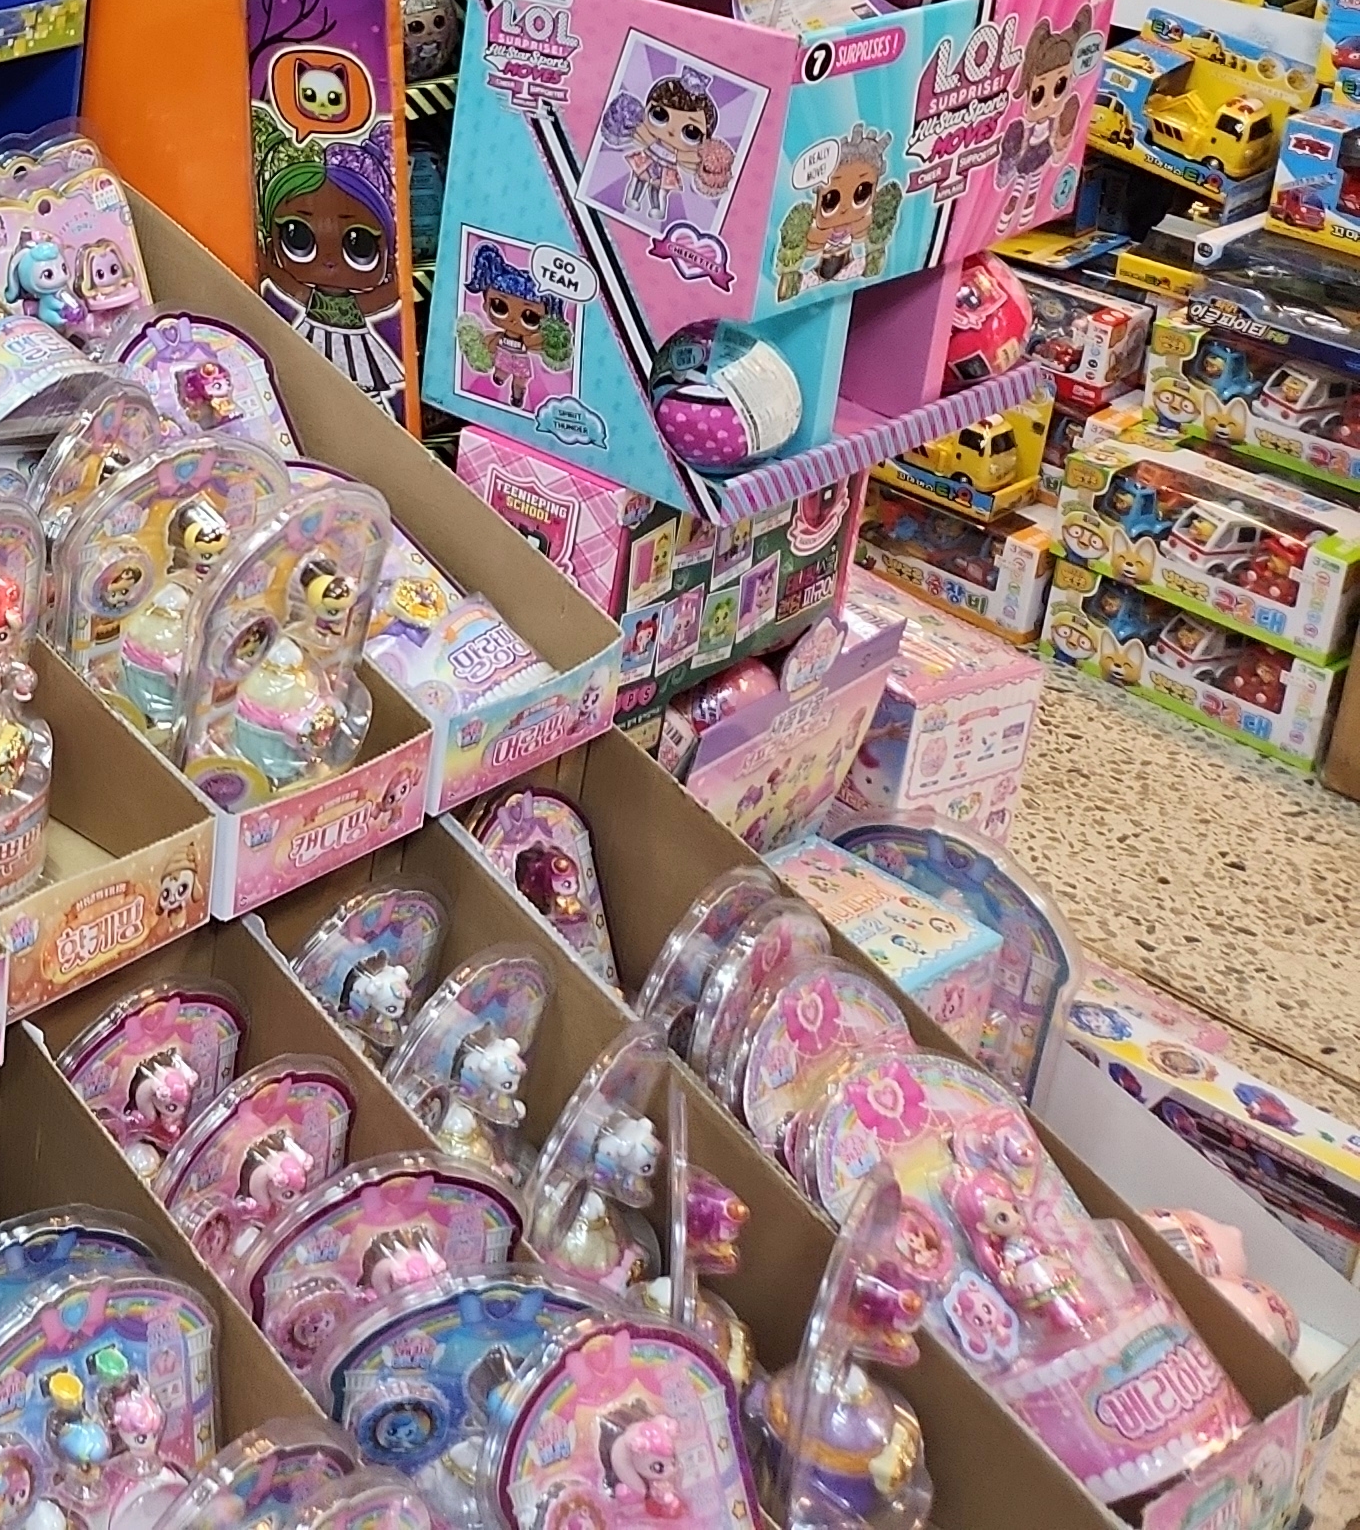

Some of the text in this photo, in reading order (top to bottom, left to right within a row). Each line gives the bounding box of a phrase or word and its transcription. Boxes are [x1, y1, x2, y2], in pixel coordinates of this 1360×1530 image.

[813, 51, 826, 77] 7
[930, 72, 1005, 113] SURPRISE!
[929, 116, 1000, 160] MOVES
[808, 147, 831, 166] REALLY
[958, 146, 1000, 169] SUPPORTER
[917, 169, 942, 184] CHEER
[541, 265, 580, 293] TEAM
[552, 257, 576, 276] GO
[1189, 302, 1266, 339] 이글파이터
[495, 478, 568, 520] TEENIEPING
[505, 496, 552, 525] SCHOOL
